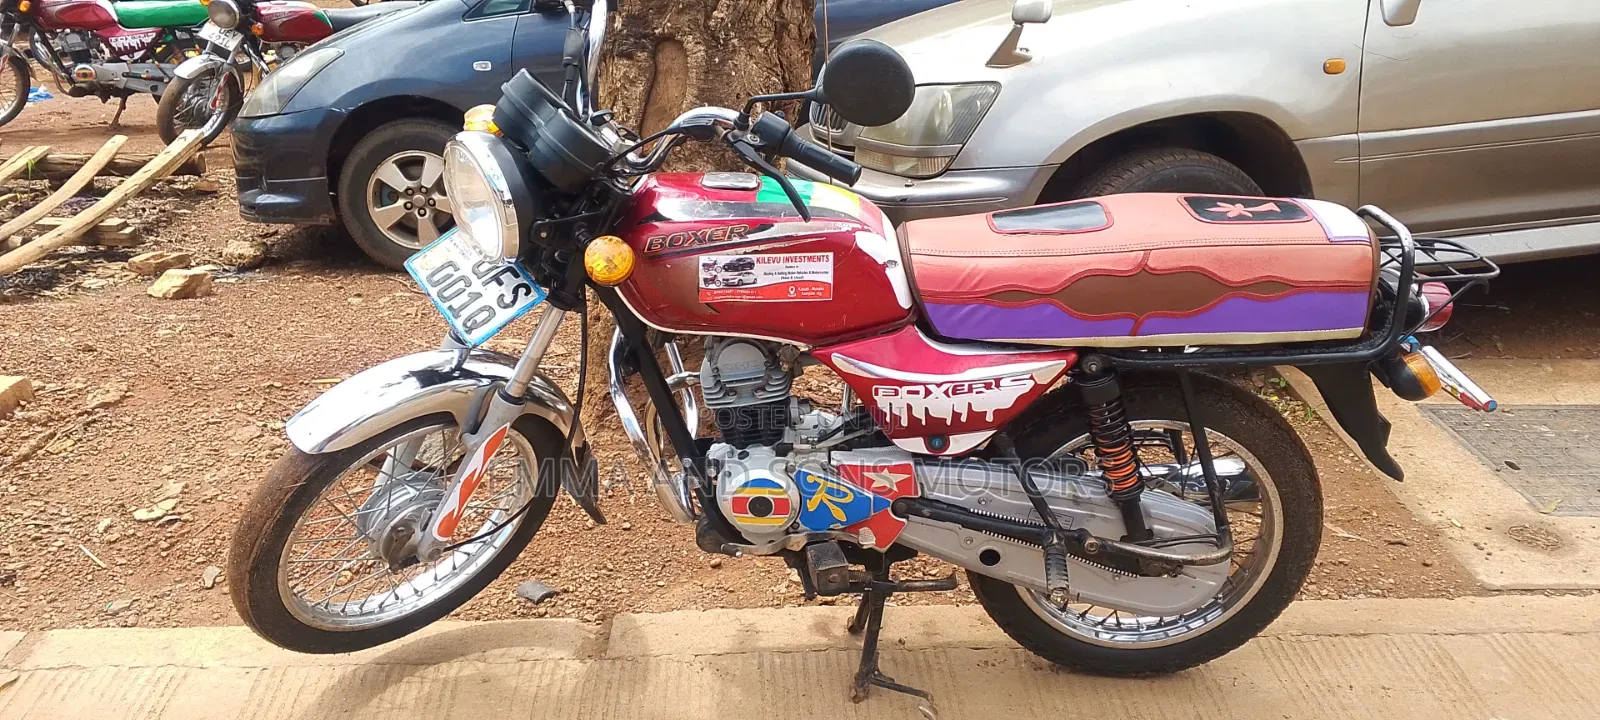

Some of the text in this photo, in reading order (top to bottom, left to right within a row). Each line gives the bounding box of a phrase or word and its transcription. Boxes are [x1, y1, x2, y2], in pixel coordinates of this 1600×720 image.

[644, 224, 749, 253] BOXER
[756, 255, 830, 264] KILEVU INVESTMENTS
[471, 259, 532, 309] UFS
